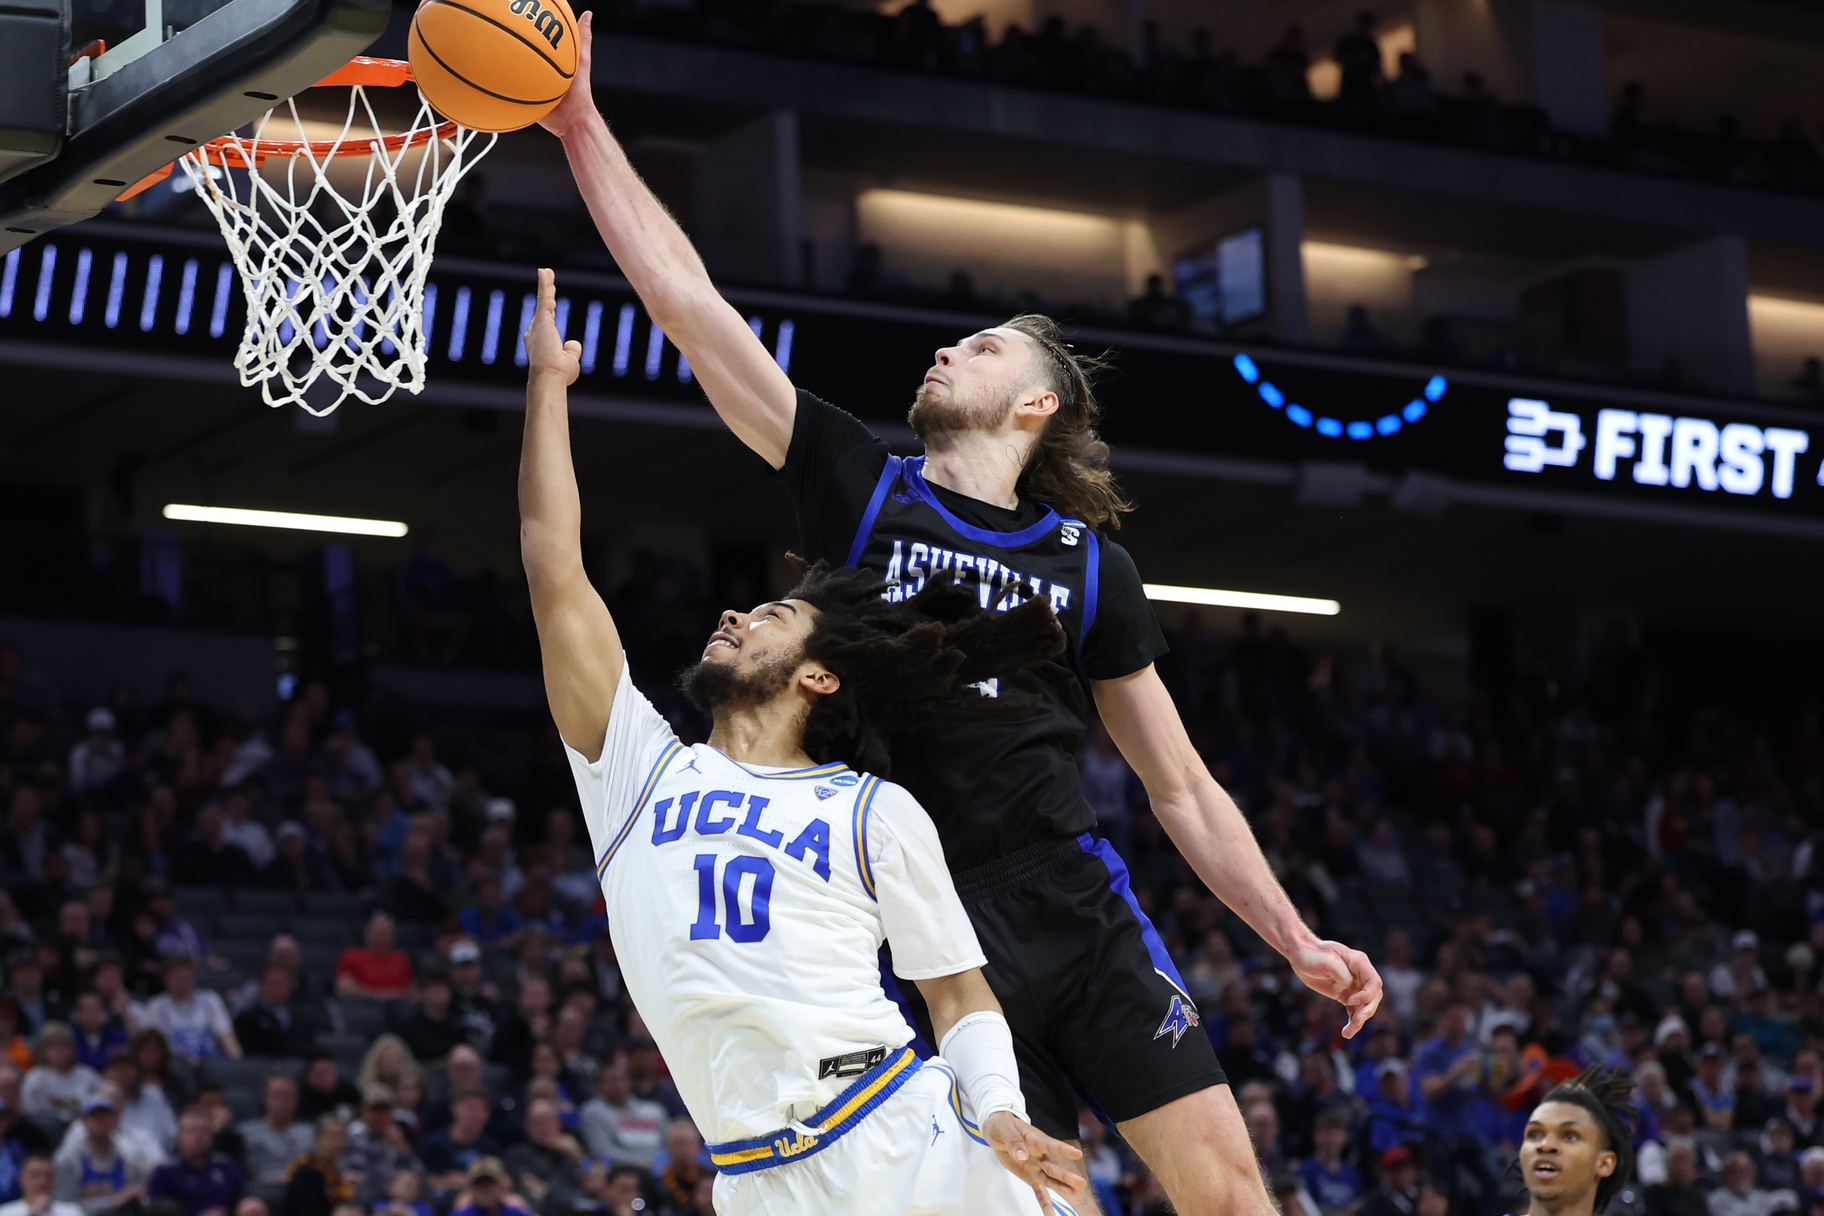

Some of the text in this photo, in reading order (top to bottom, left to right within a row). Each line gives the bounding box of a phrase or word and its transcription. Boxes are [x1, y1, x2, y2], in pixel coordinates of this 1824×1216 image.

[1593, 407, 1809, 499] FIRST
[651, 790, 831, 883] UCLA
[690, 854, 776, 943] 10
[774, 1132, 819, 1158] Ucla
